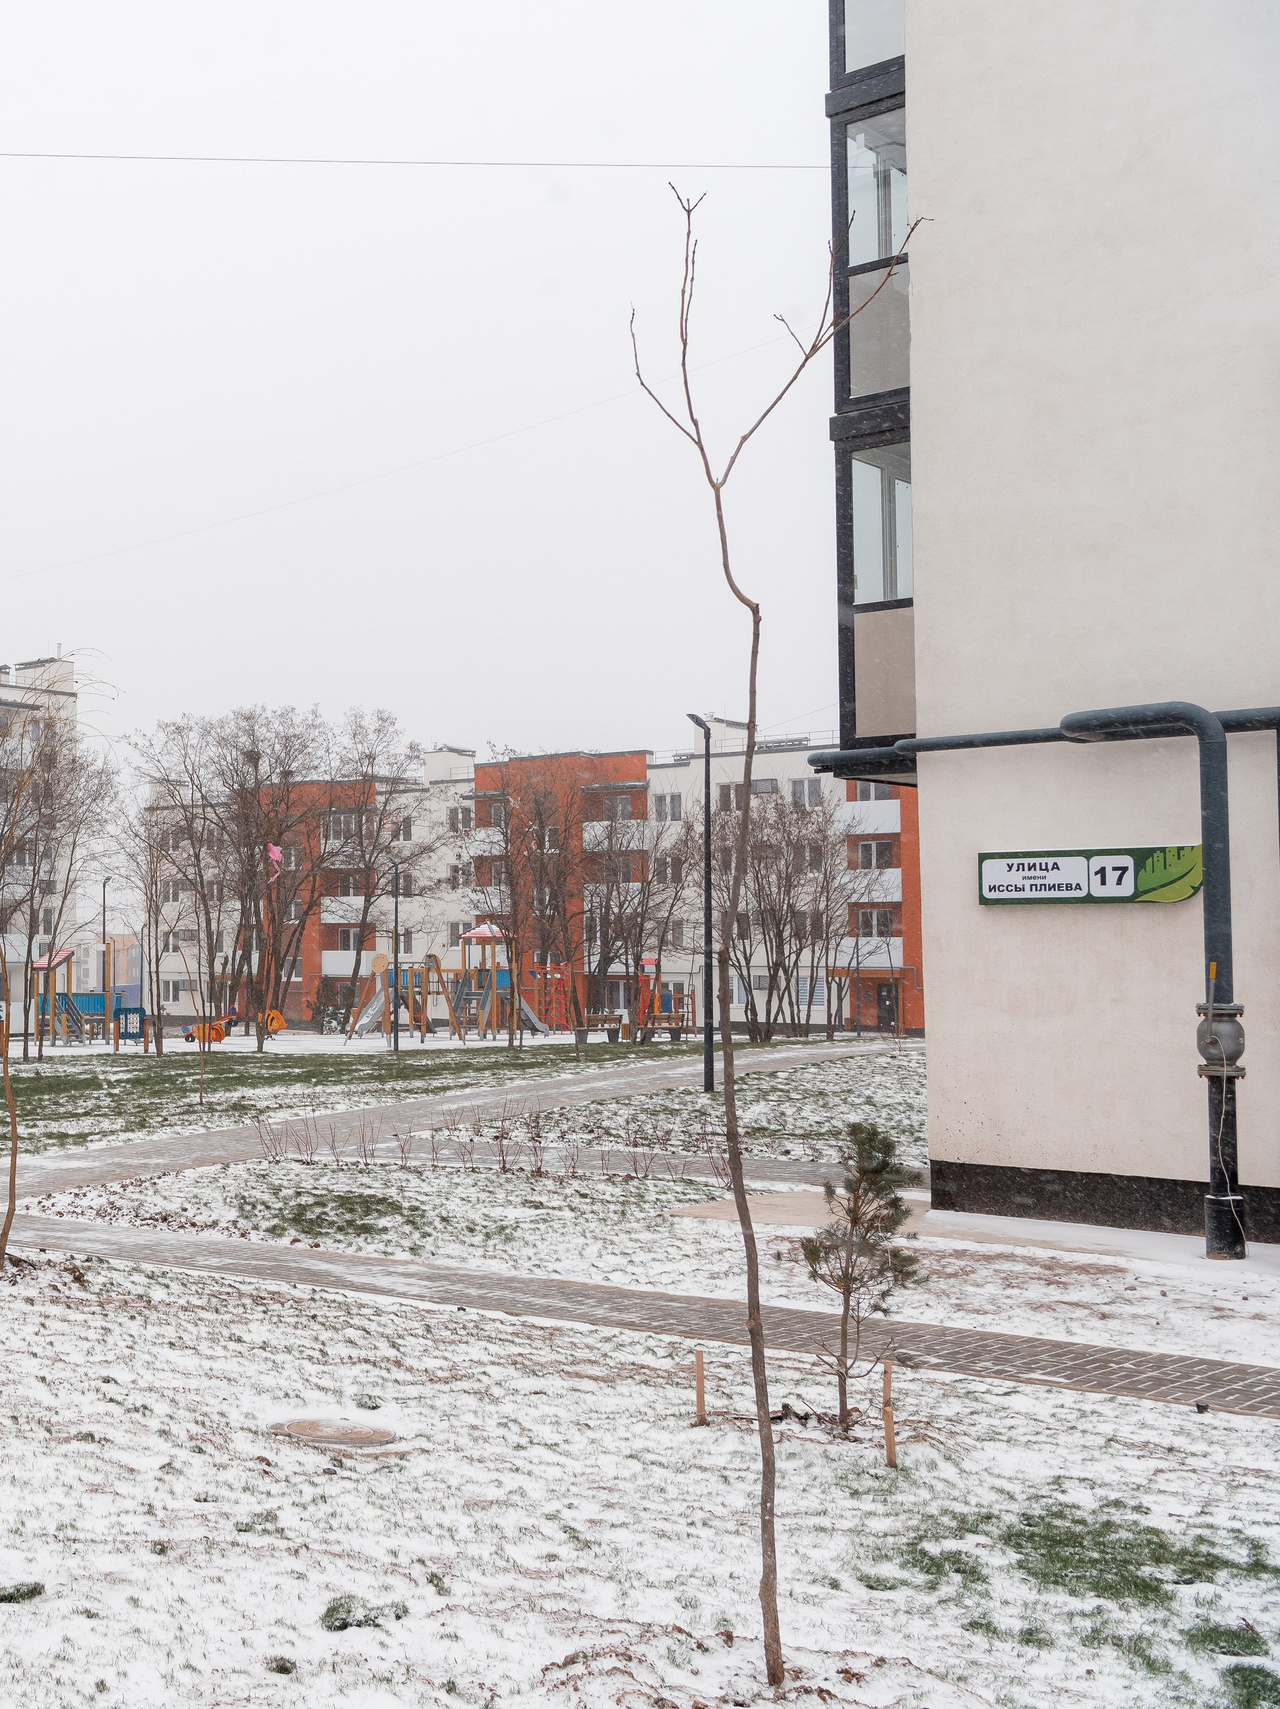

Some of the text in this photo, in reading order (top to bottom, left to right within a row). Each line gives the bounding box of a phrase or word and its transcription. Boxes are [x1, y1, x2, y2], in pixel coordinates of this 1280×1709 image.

[1006, 862, 1060, 873] УЛИЦА
[1093, 866, 1129, 886] 17
[988, 883, 1082, 893] ИССЫ ПЛИЕВА
